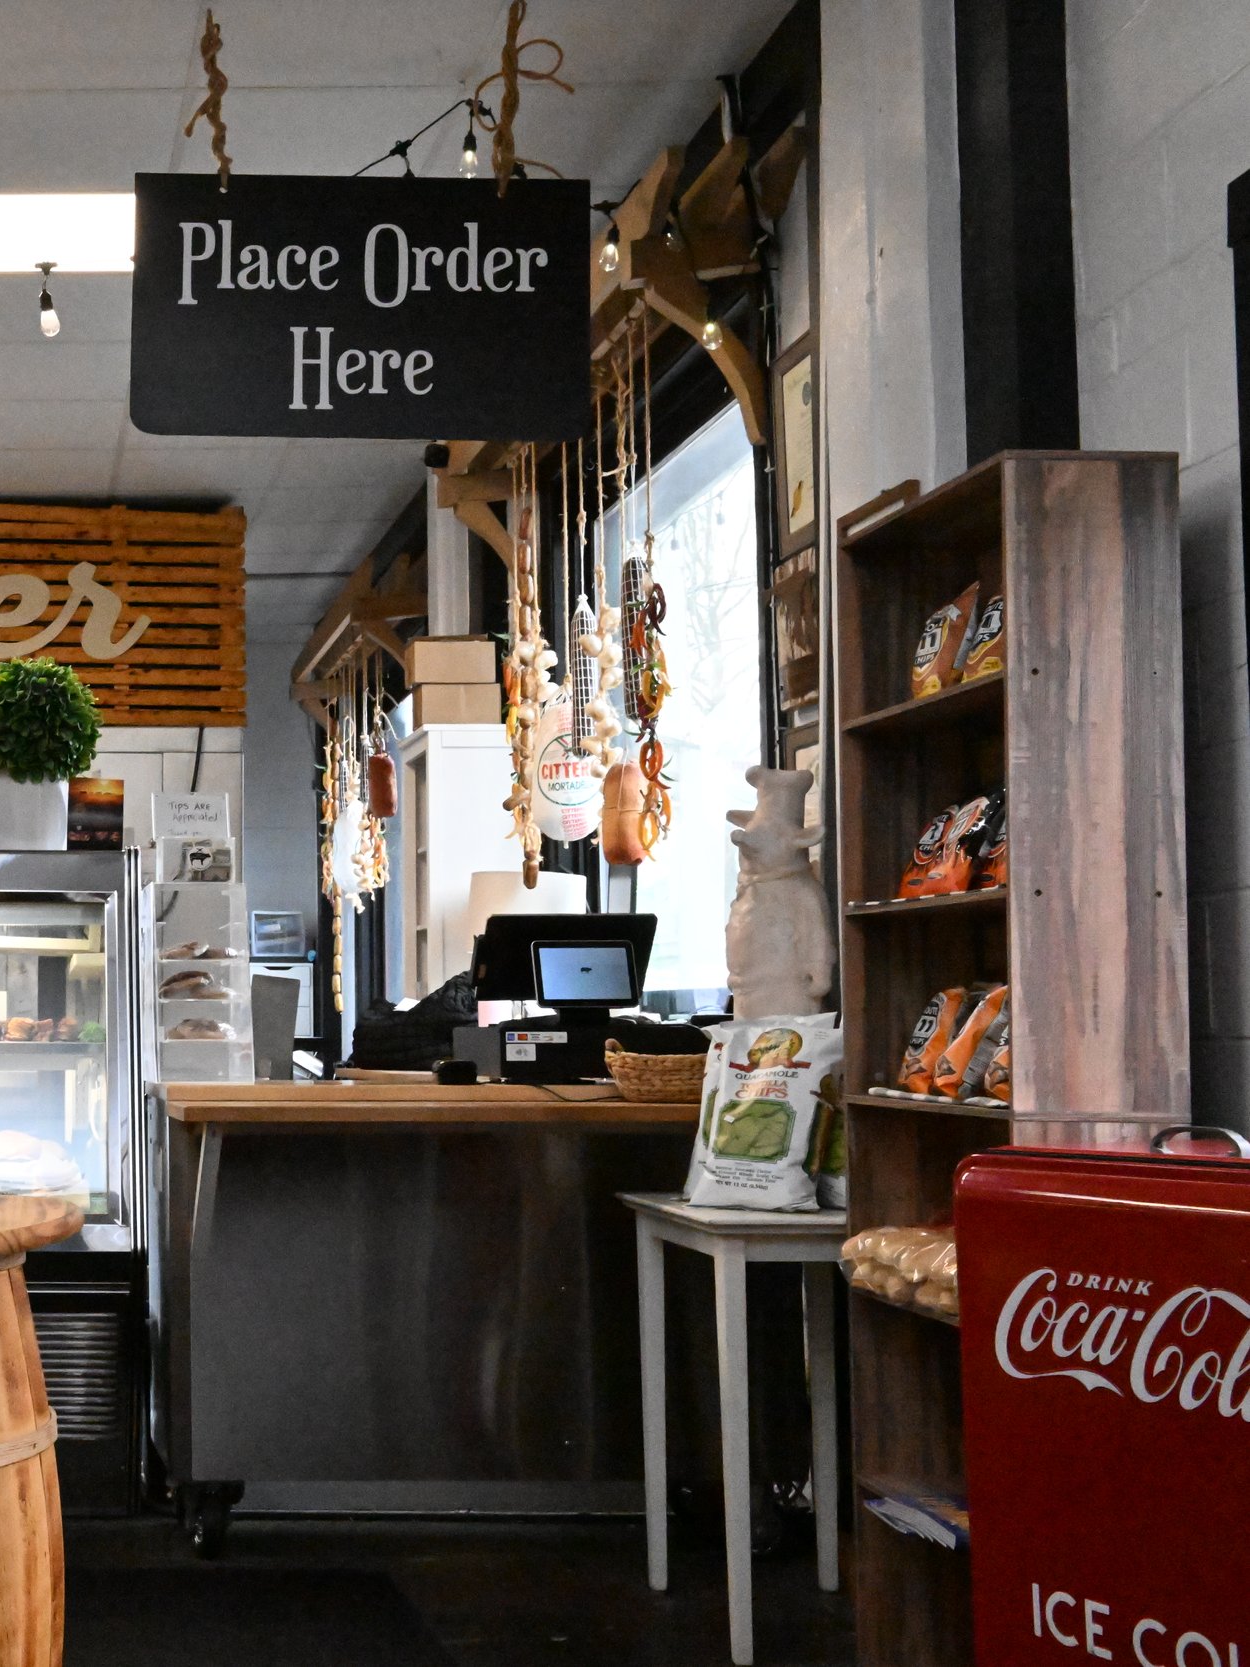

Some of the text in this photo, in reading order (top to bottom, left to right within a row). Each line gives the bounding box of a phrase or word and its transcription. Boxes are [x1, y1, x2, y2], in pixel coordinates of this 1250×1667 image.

[178, 219, 549, 308] Place Order
[288, 326, 435, 410] Here
[541, 762, 591, 780] CITTER
[1066, 1272, 1154, 1297] DRINK
[995, 1267, 1250, 1423] Coca-Col
[1031, 1582, 1113, 1661] ICE
